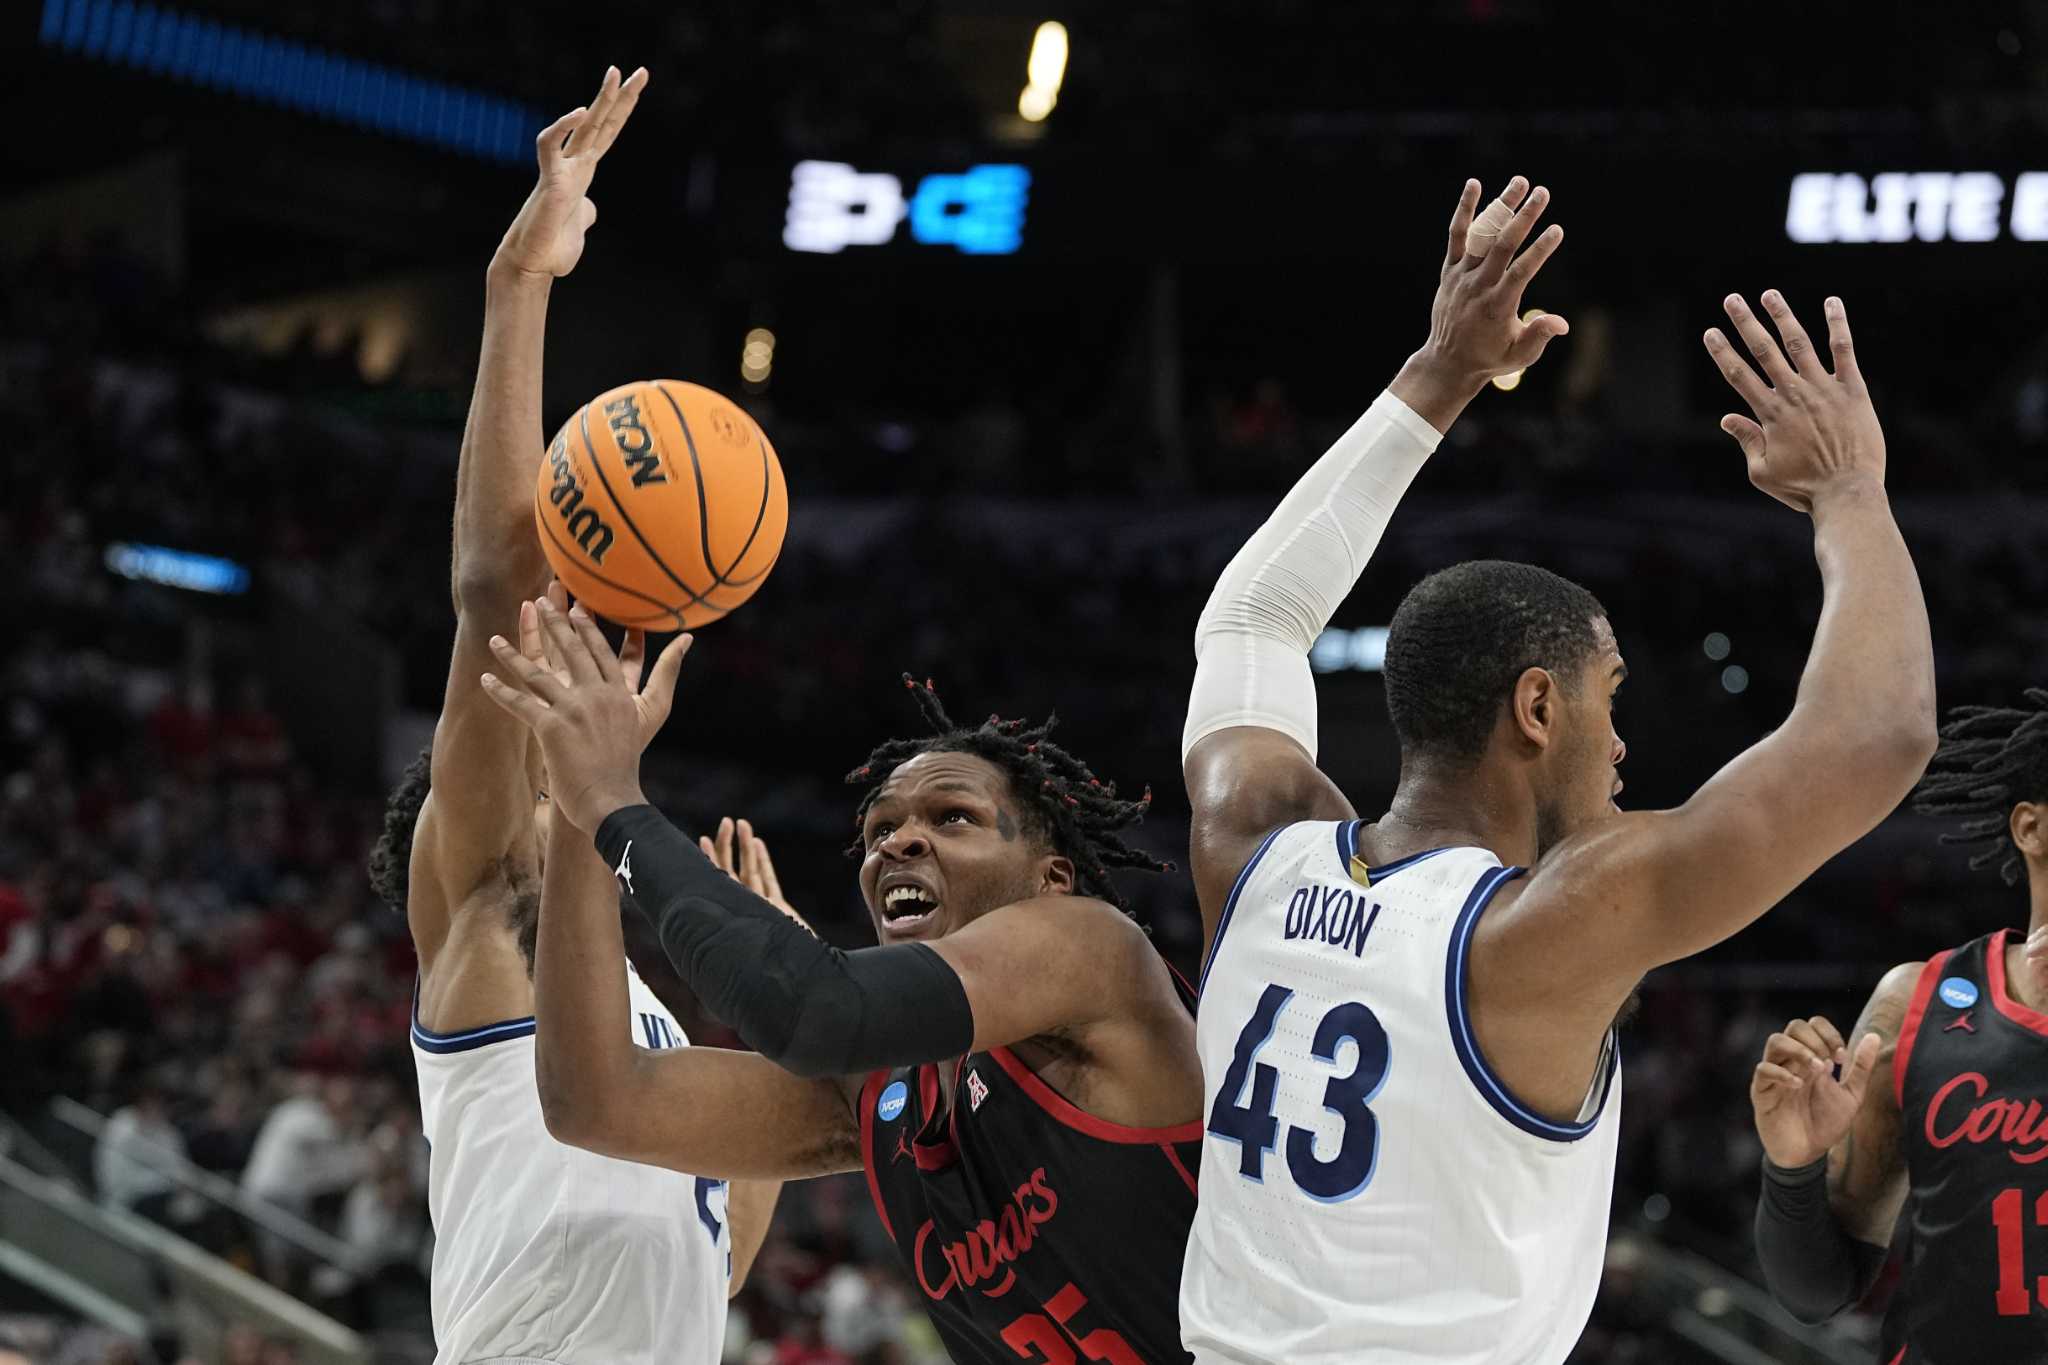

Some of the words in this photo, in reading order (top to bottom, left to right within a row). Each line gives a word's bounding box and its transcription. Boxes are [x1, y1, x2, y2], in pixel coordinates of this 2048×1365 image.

[1786, 172, 2004, 243] ELITE
[603, 394, 667, 489] NCAA
[551, 422, 614, 566] Wilso
[1284, 885, 1381, 958] DIXON
[1944, 988, 1975, 1004] NCAA
[881, 1096, 905, 1113] NCAA
[1207, 983, 1392, 1204] 43
[914, 1167, 1057, 1300] Cugars
